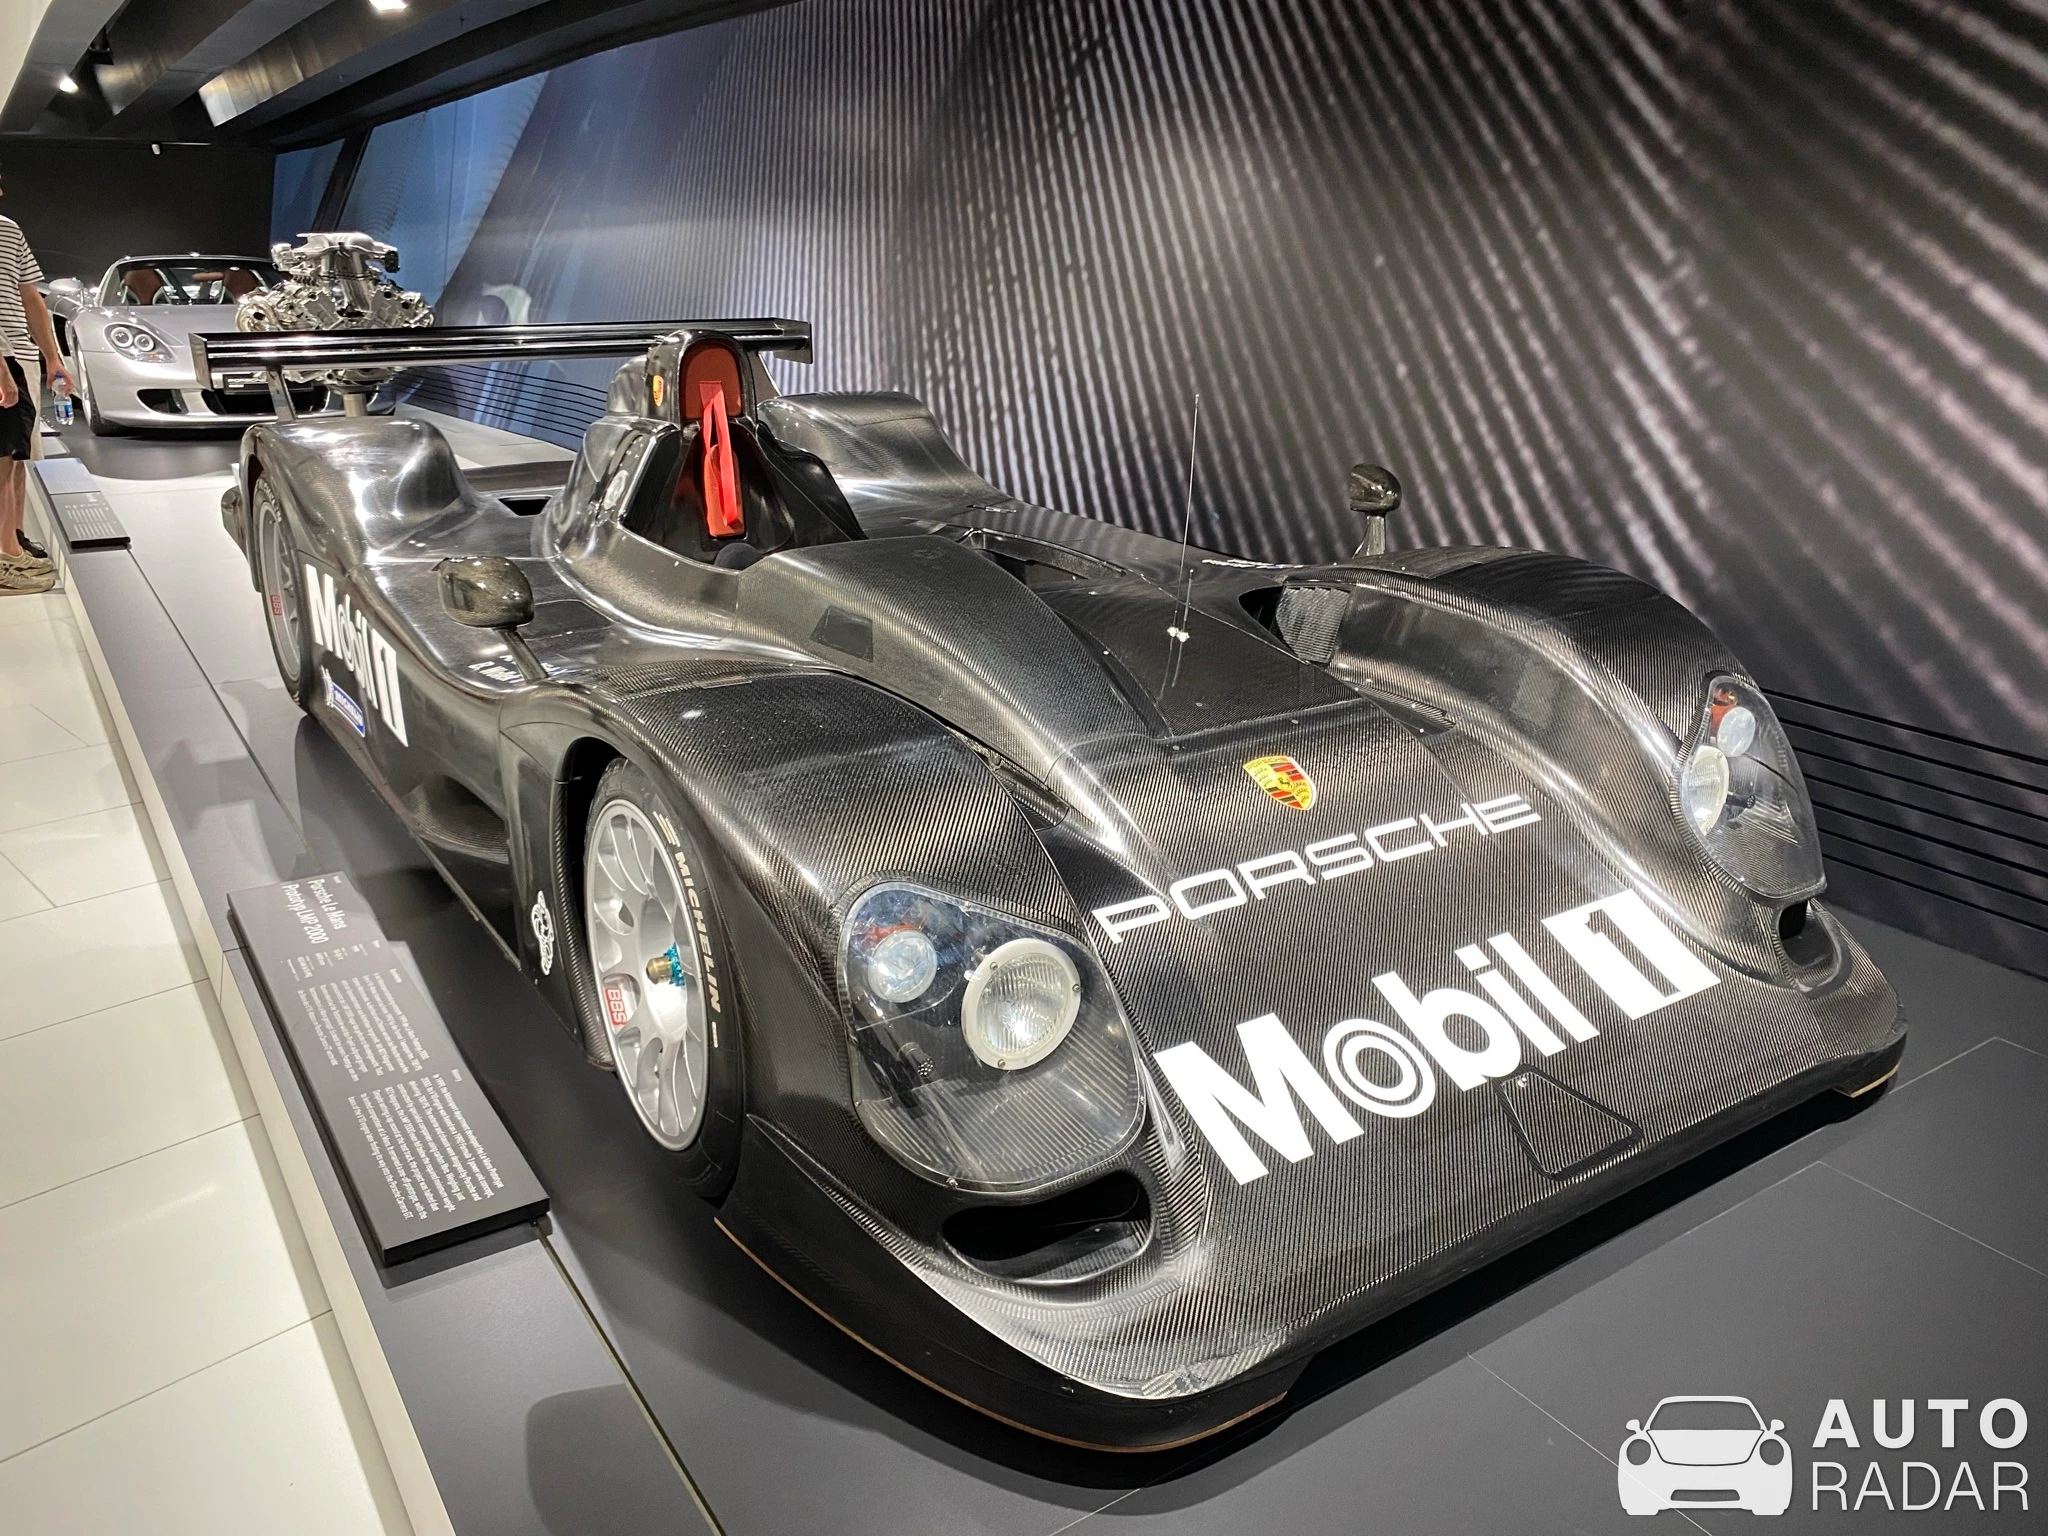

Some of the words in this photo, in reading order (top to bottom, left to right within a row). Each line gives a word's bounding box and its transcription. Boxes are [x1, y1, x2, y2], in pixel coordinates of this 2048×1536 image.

[306, 563, 378, 710] Mobil
[281, 883, 307, 911] Prototyp
[304, 924, 329, 944] 2000
[307, 878, 333, 904] Porsche
[326, 910, 347, 929] Mans
[675, 852, 722, 1014] MICHELIN
[1092, 794, 1541, 945] PORSCHE
[605, 988, 627, 1025] BBS
[1152, 931, 1599, 1186] Mobil
